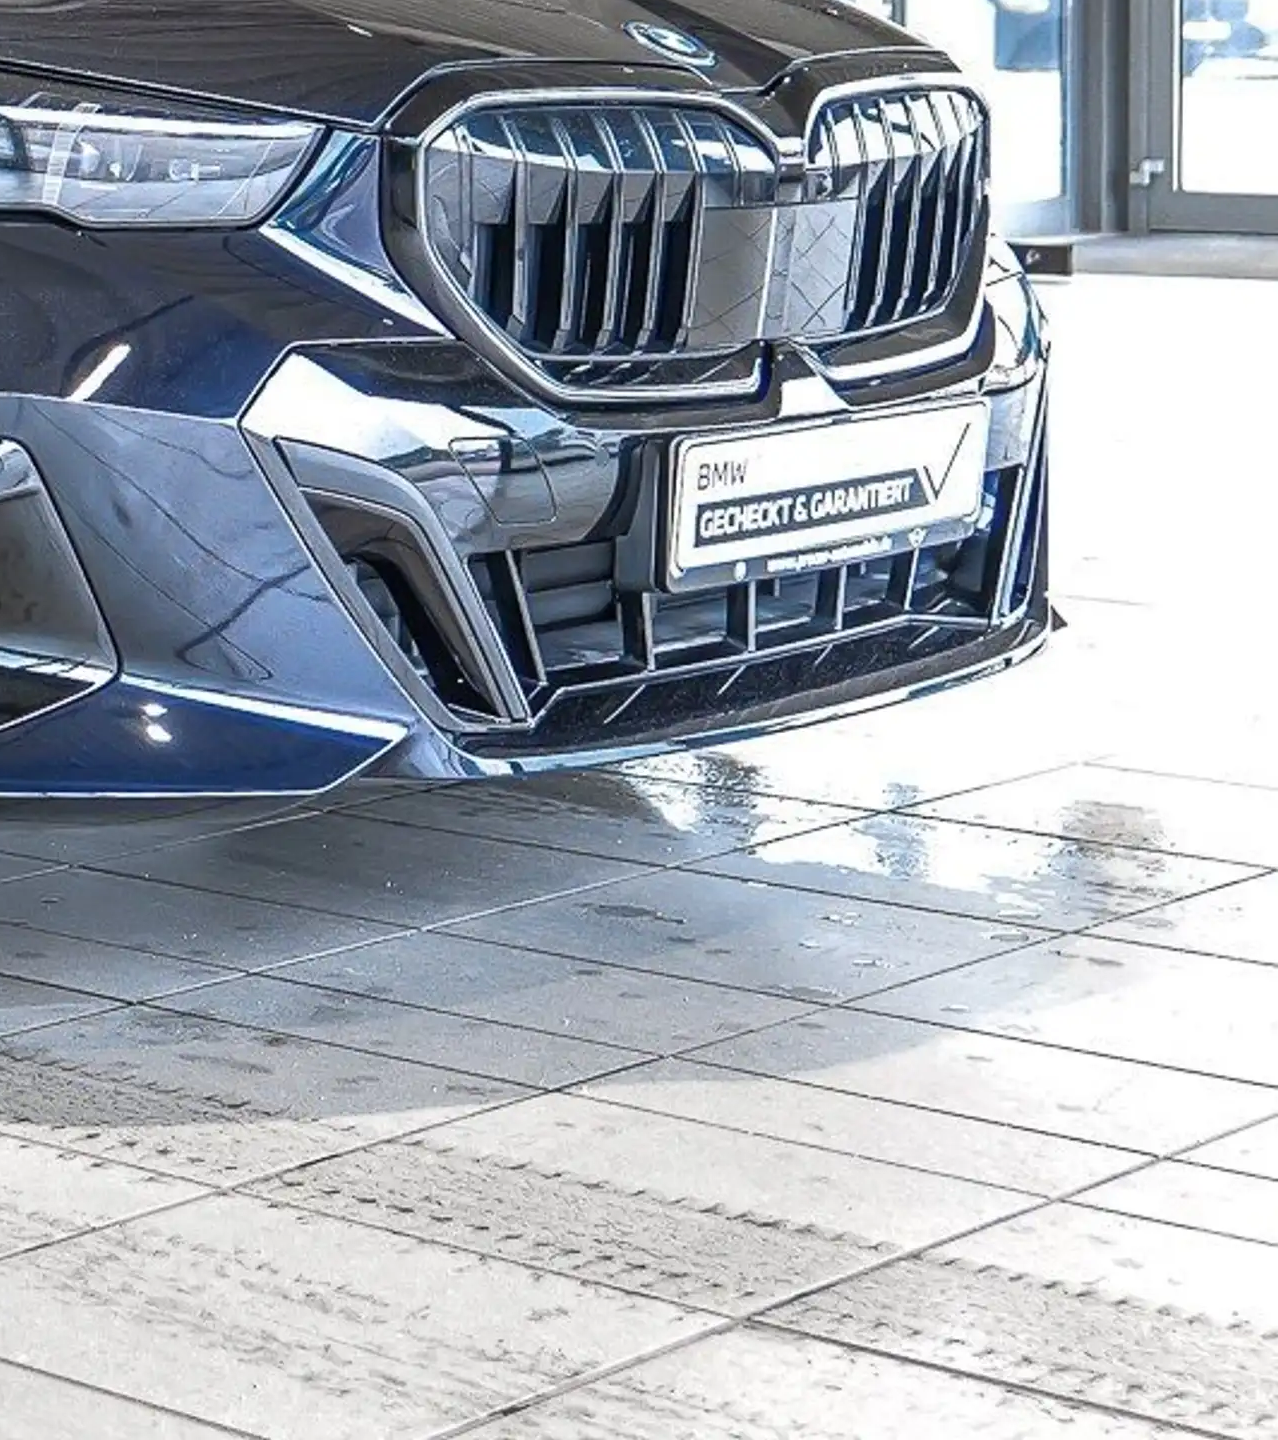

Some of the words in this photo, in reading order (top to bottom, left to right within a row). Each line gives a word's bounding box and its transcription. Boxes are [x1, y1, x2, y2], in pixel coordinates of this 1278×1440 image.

[698, 459, 748, 490] BMW
[700, 498, 793, 538] GECHECKT
[794, 495, 808, 522] &
[810, 477, 914, 519] GARANTIERT
